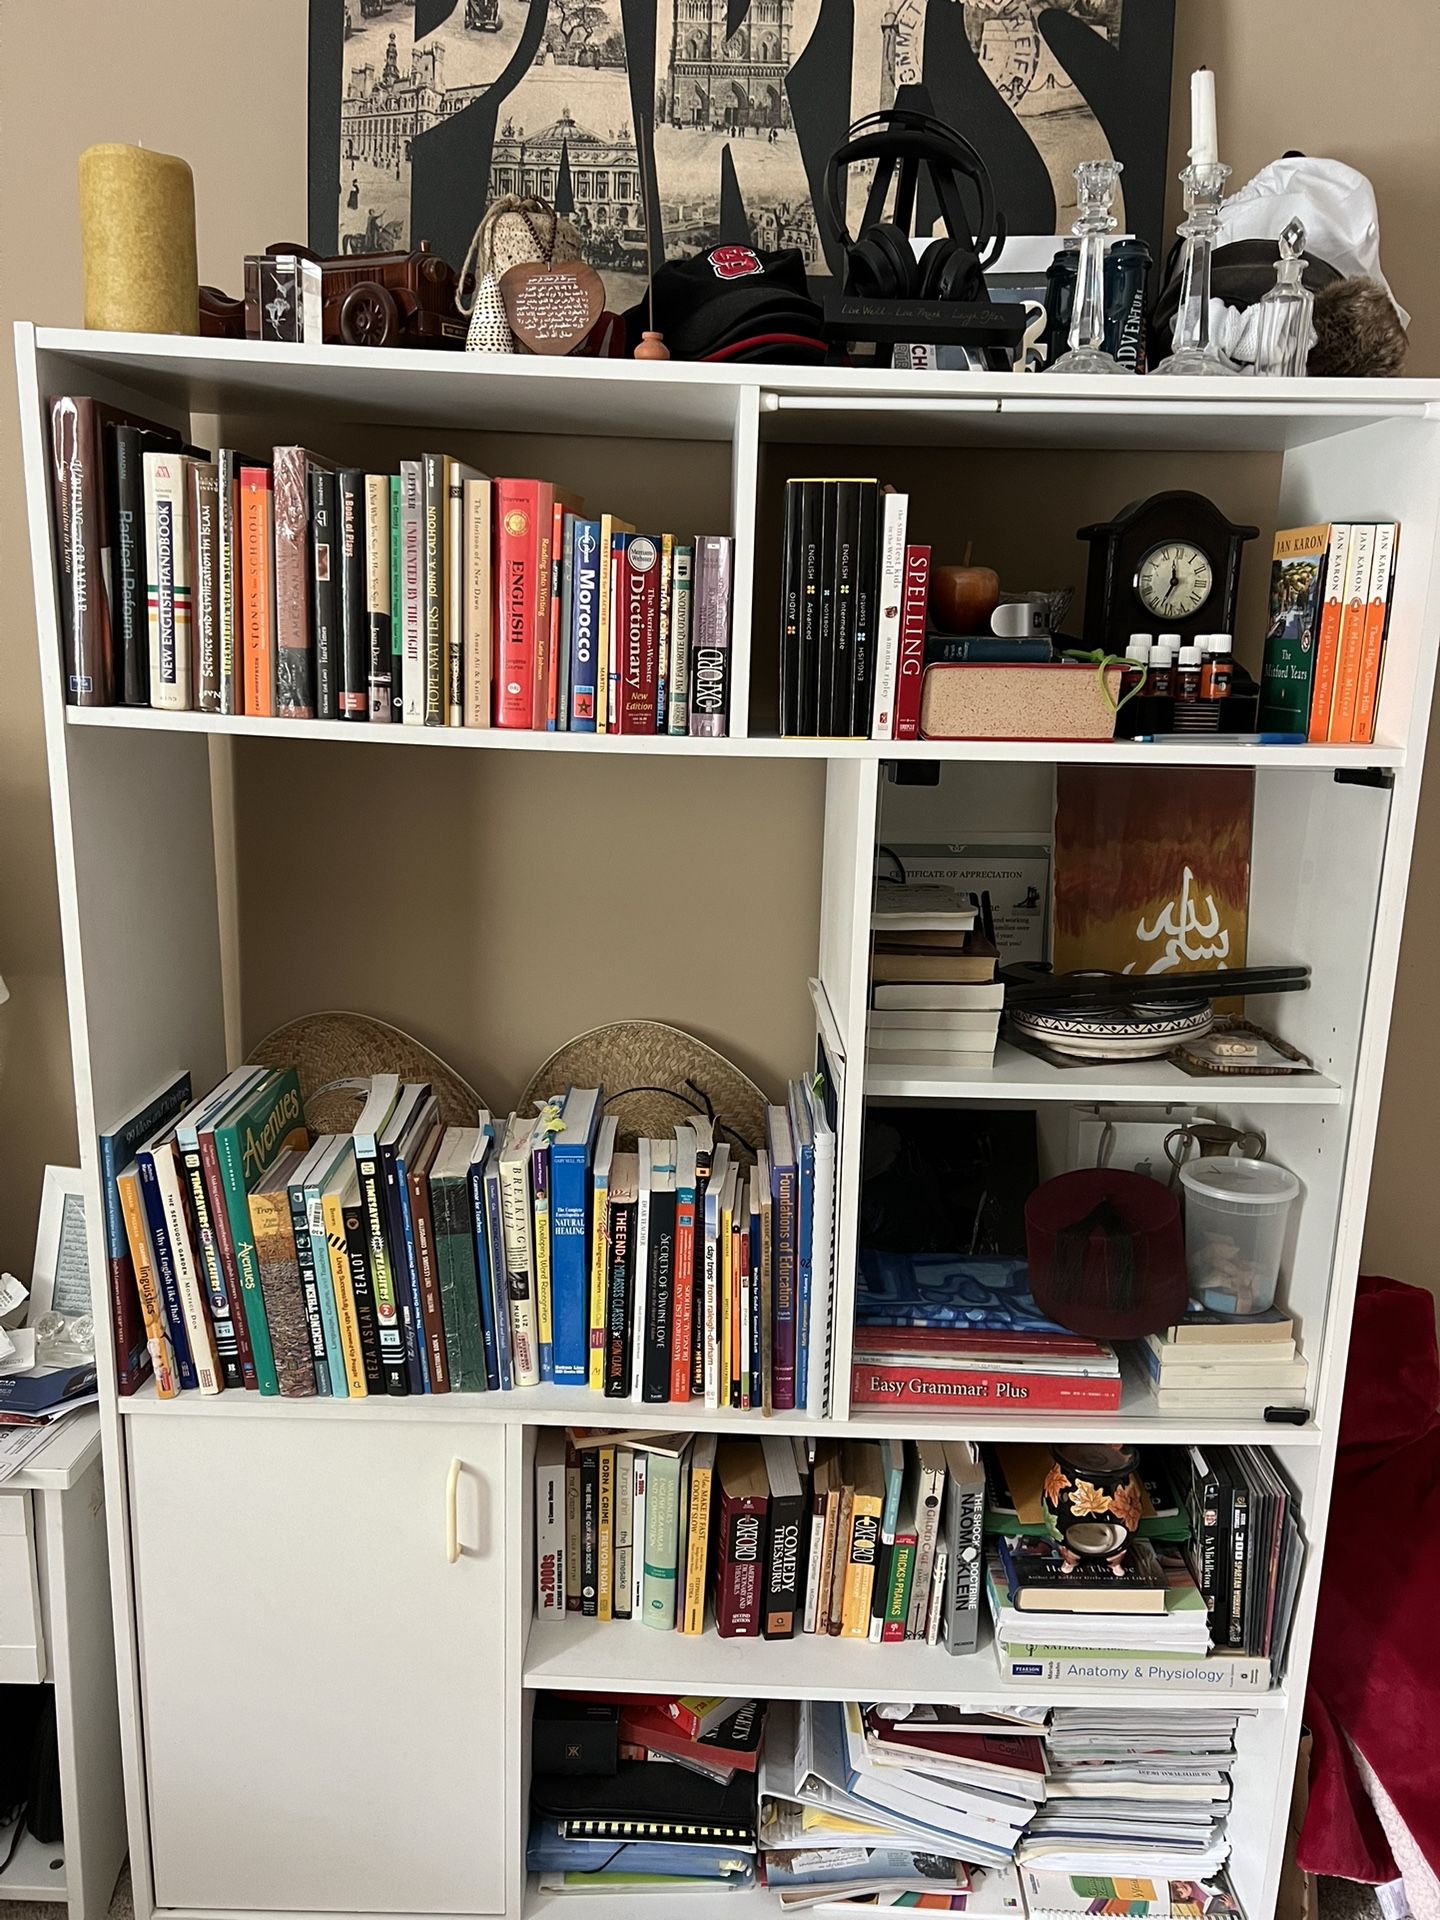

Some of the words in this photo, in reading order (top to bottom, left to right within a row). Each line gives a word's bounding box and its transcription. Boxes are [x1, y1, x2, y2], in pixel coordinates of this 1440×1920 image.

[119, 441, 127, 480] RAMADAN
[408, 473, 416, 509] LEFEVER
[346, 500, 354, 522] Book
[119, 510, 134, 573] Radical
[346, 524, 354, 532] of
[428, 505, 436, 556] CALHOUN
[1337, 531, 1345, 550] JAN
[1359, 532, 1368, 551] JAN
[1380, 530, 1389, 551] JAN
[158, 505, 171, 586] HANDBOOK
[345, 533, 354, 557] Plays
[408, 521, 417, 585] UNDAUNTED
[539, 538, 550, 569] Reading
[1276, 540, 1291, 555] JAN
[1293, 535, 1324, 551] KARON
[428, 559, 437, 570] A.
[807, 543, 815, 580] ENGLISH
[842, 543, 850, 579] ENGLISH
[1331, 554, 1343, 591] KARON
[1353, 556, 1365, 593] KARON
[1375, 554, 1387, 591] KARON
[428, 571, 438, 598] JOHN
[539, 571, 548, 586] Into
[407, 587, 417, 600] BY
[511, 560, 524, 644] ENGLISH
[538, 588, 547, 617] Writing
[788, 592, 796, 620] AUDIO
[121, 578, 136, 640] Reform
[160, 591, 172, 645] ENGLISH
[408, 604, 417, 625] THE
[578, 569, 596, 663] Morocco
[677, 590, 687, 640] QUOTATIONS
[806, 602, 814, 640] Advanced
[858, 592, 867, 627] Essential
[903, 557, 928, 676] SPELLING
[319, 626, 327, 646] Times
[427, 606, 439, 668] MATTERS
[625, 574, 646, 689] Dictionary
[839, 601, 847, 650] Intermediate
[1368, 624, 1379, 647] These
[319, 647, 328, 663] Hard
[407, 629, 417, 660] FIGHT
[538, 640, 546, 655] Katie
[882, 637, 892, 670] amanda
[1281, 649, 1292, 661] The
[1364, 648, 1375, 669] High,
[162, 651, 173, 679] NEW
[537, 657, 545, 681] Johnson
[675, 642, 684, 680] FAVORITE
[857, 647, 865, 681] ENGLISH
[428, 671, 440, 713] HOPE
[675, 681, 683, 691] MY
[696, 649, 724, 708] OXFORD
[881, 674, 892, 699] ripley
[1362, 671, 1373, 693] Green
[626, 702, 653, 711] Edition
[631, 692, 648, 700] New
[1360, 694, 1371, 715] Hills
[889, 870, 945, 878] CETIFICATE
[960, 871, 1024, 879] APPRECIATION
[242, 1087, 300, 1180] Avenues
[503, 1180, 515, 1230] NIGHT
[512, 1167, 525, 1243] BREAKING
[778, 1172, 794, 1239] Foundations
[170, 1208, 183, 1247] SENSUOUS
[189, 1171, 211, 1229] TIMESAVERS
[204, 1244, 221, 1292] TEACHERS
[554, 1219, 585, 1227] NATURAL
[554, 1227, 585, 1236] HEALING
[615, 1210, 628, 1232] THE
[155, 1228, 168, 1247] Why
[538, 1219, 548, 1259] Developing
[614, 1233, 628, 1255] END
[778, 1241, 794, 1252] of
[176, 1249, 189, 1276] GARDEN
[238, 1241, 257, 1291] Avenues
[336, 1257, 346, 1274] Living
[658, 1233, 672, 1275] SECRETS
[705, 1245, 715, 1260] day
[159, 1257, 173, 1285] English
[303, 1270, 315, 1283] IN
[351, 1252, 368, 1295] ZEALOT
[539, 1260, 550, 1277] Word
[612, 1264, 626, 1298] MOLASSES
[658, 1275, 669, 1289] OF
[778, 1256, 793, 1308] Education
[139, 1265, 158, 1315] linguistics
[165, 1286, 177, 1302] Like
[305, 1284, 319, 1313] THEM
[337, 1275, 351, 1312] Successfully
[541, 1278, 552, 1323] Recognition
[706, 1283, 715, 1303] from
[167, 1303, 181, 1324] That?
[343, 1312, 352, 1325] with
[520, 1313, 528, 1327] LIZ
[611, 1299, 625, 1331] CLASSES
[656, 1289, 669, 1324] DIVINE
[308, 1314, 325, 1357] PACKING
[360, 1306, 376, 1344] ASLAN
[656, 1325, 666, 1349] LOVE
[705, 1304, 715, 1365] raleigh-durham
[611, 1339, 623, 1355] RON
[350, 1357, 360, 1379] People
[366, 1351, 380, 1379] REZA
[610, 1355, 624, 1377] CLARK
[869, 1376, 907, 1397] Easy
[995, 1384, 1028, 1400] Plus
[602, 1458, 610, 1485] BORN
[602, 1486, 610, 1494] A
[692, 1480, 700, 1502] COOK
[975, 1492, 983, 1512] THE
[601, 1496, 610, 1525] CRIME
[692, 1503, 700, 1511] IT
[958, 1492, 975, 1549] NAOMI
[620, 1530, 629, 1544] the
[691, 1511, 699, 1534] SLOW
[922, 1509, 936, 1542] GILDED
[972, 1513, 982, 1547] SHOCK
[600, 1530, 609, 1566] TREVOR
[735, 1517, 759, 1561] OXFORD
[853, 1518, 878, 1563] OXFORD
[1234, 1531, 1245, 1560] 300
[771, 1525, 785, 1594] THESAURUS
[782, 1525, 798, 1593] COMEDY
[920, 1542, 932, 1566] CAGE
[600, 1567, 608, 1594] NOAH
[619, 1550, 628, 1589] namesake
[1233, 1561, 1243, 1589] SPARTAN
[954, 1564, 972, 1611] KLEIN
[968, 1561, 979, 1610] DOCTRINE
[1232, 1589, 1242, 1618] WORKOUT
[1067, 1664, 1130, 1681] Anatomy
[1134, 1667, 1143, 1678] &
[1148, 1667, 1225, 1684] Physiology
